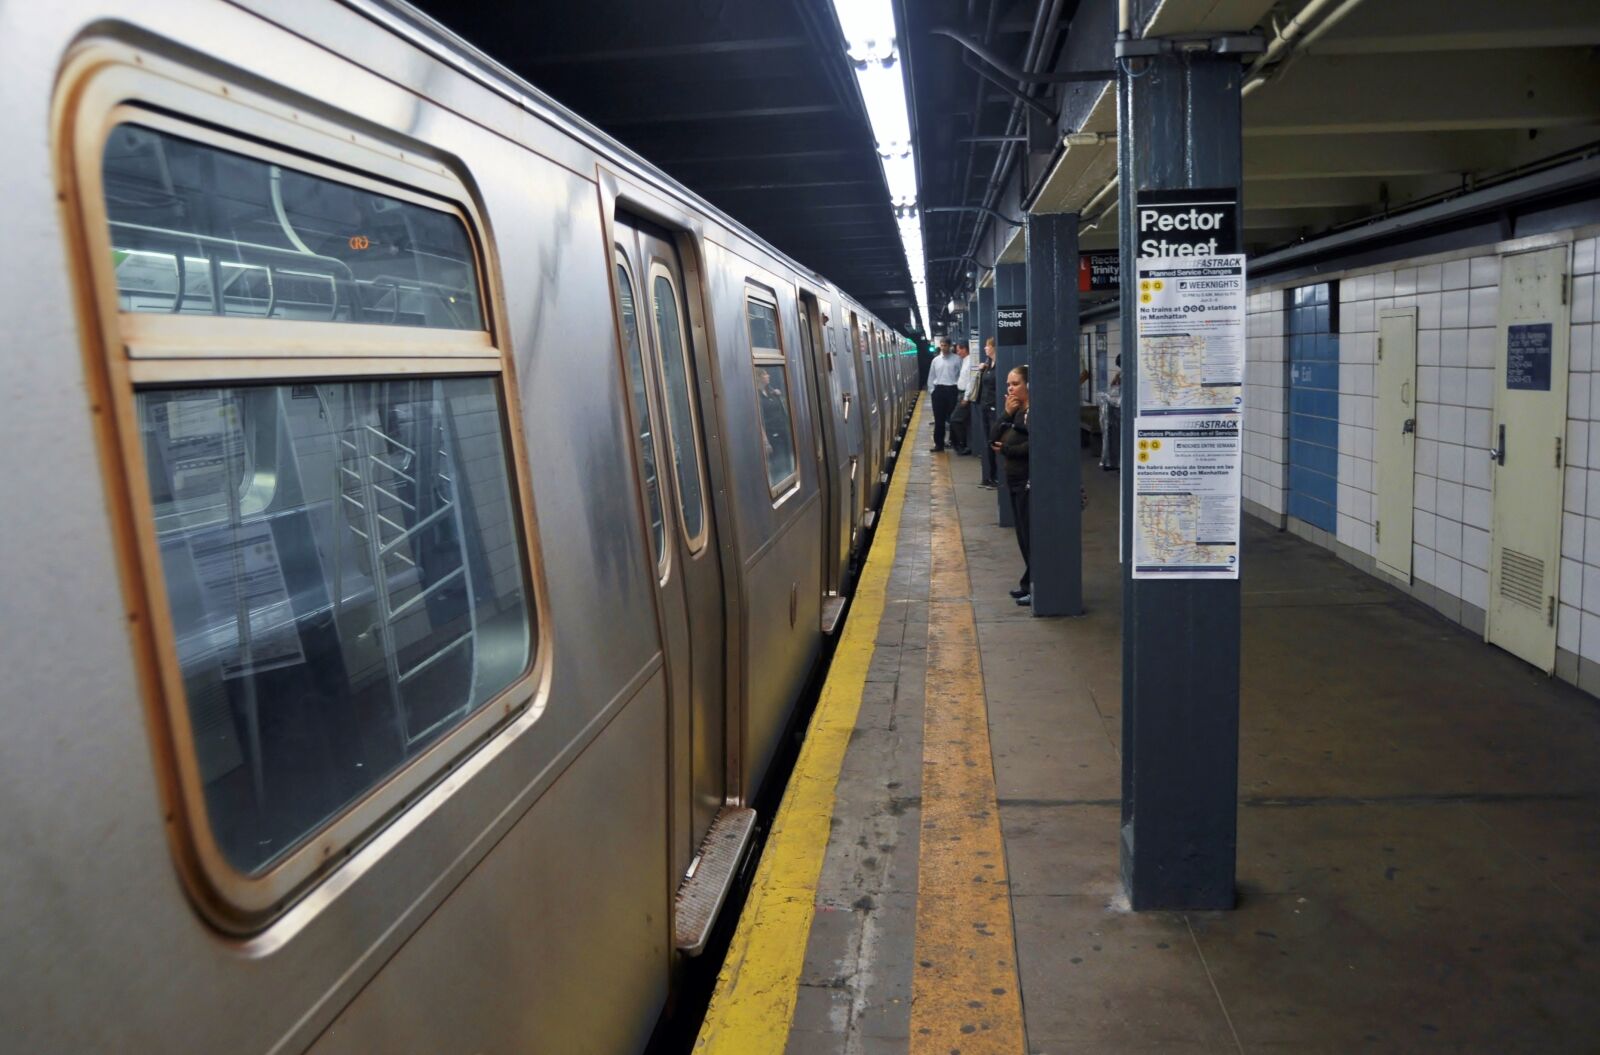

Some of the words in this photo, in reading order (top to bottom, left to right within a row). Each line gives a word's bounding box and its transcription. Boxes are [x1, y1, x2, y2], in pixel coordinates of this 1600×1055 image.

[1140, 208, 1224, 232] Rector
[1141, 238, 1218, 259] Street
[1091, 256, 1119, 265] Recto
[1197, 258, 1242, 268] FASTRACK
[1091, 265, 1119, 275] Trinity
[1189, 280, 1239, 289] WEEKNIGHTS
[1195, 420, 1238, 429] FASTRACK
